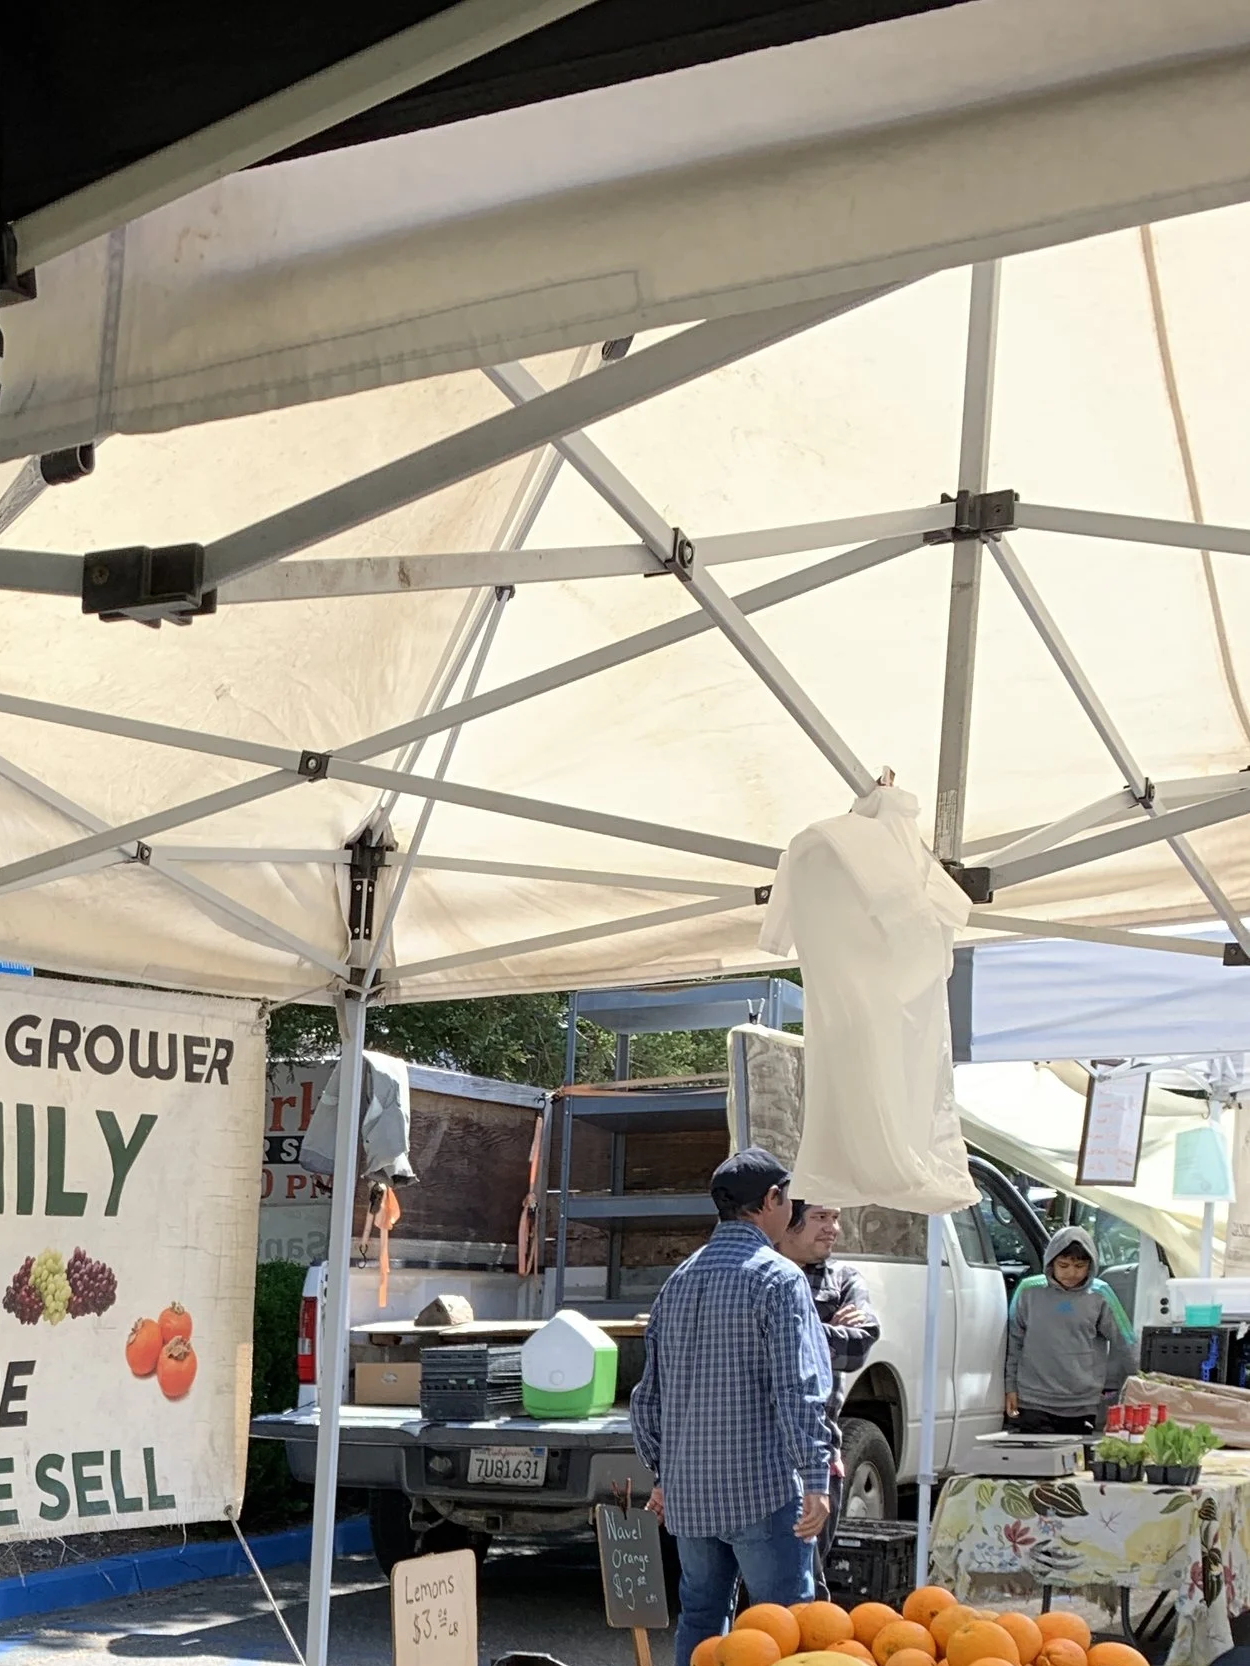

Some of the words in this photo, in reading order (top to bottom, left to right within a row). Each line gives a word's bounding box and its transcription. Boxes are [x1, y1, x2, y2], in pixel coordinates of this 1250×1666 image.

[4, 1014, 235, 1086] GROWER
[34, 1446, 177, 1519] SELL
[475, 1458, 539, 1480] 7U81631
[604, 1508, 642, 1541] Navel
[612, 1549, 650, 1573] Orange
[405, 1575, 455, 1605] Lemons
